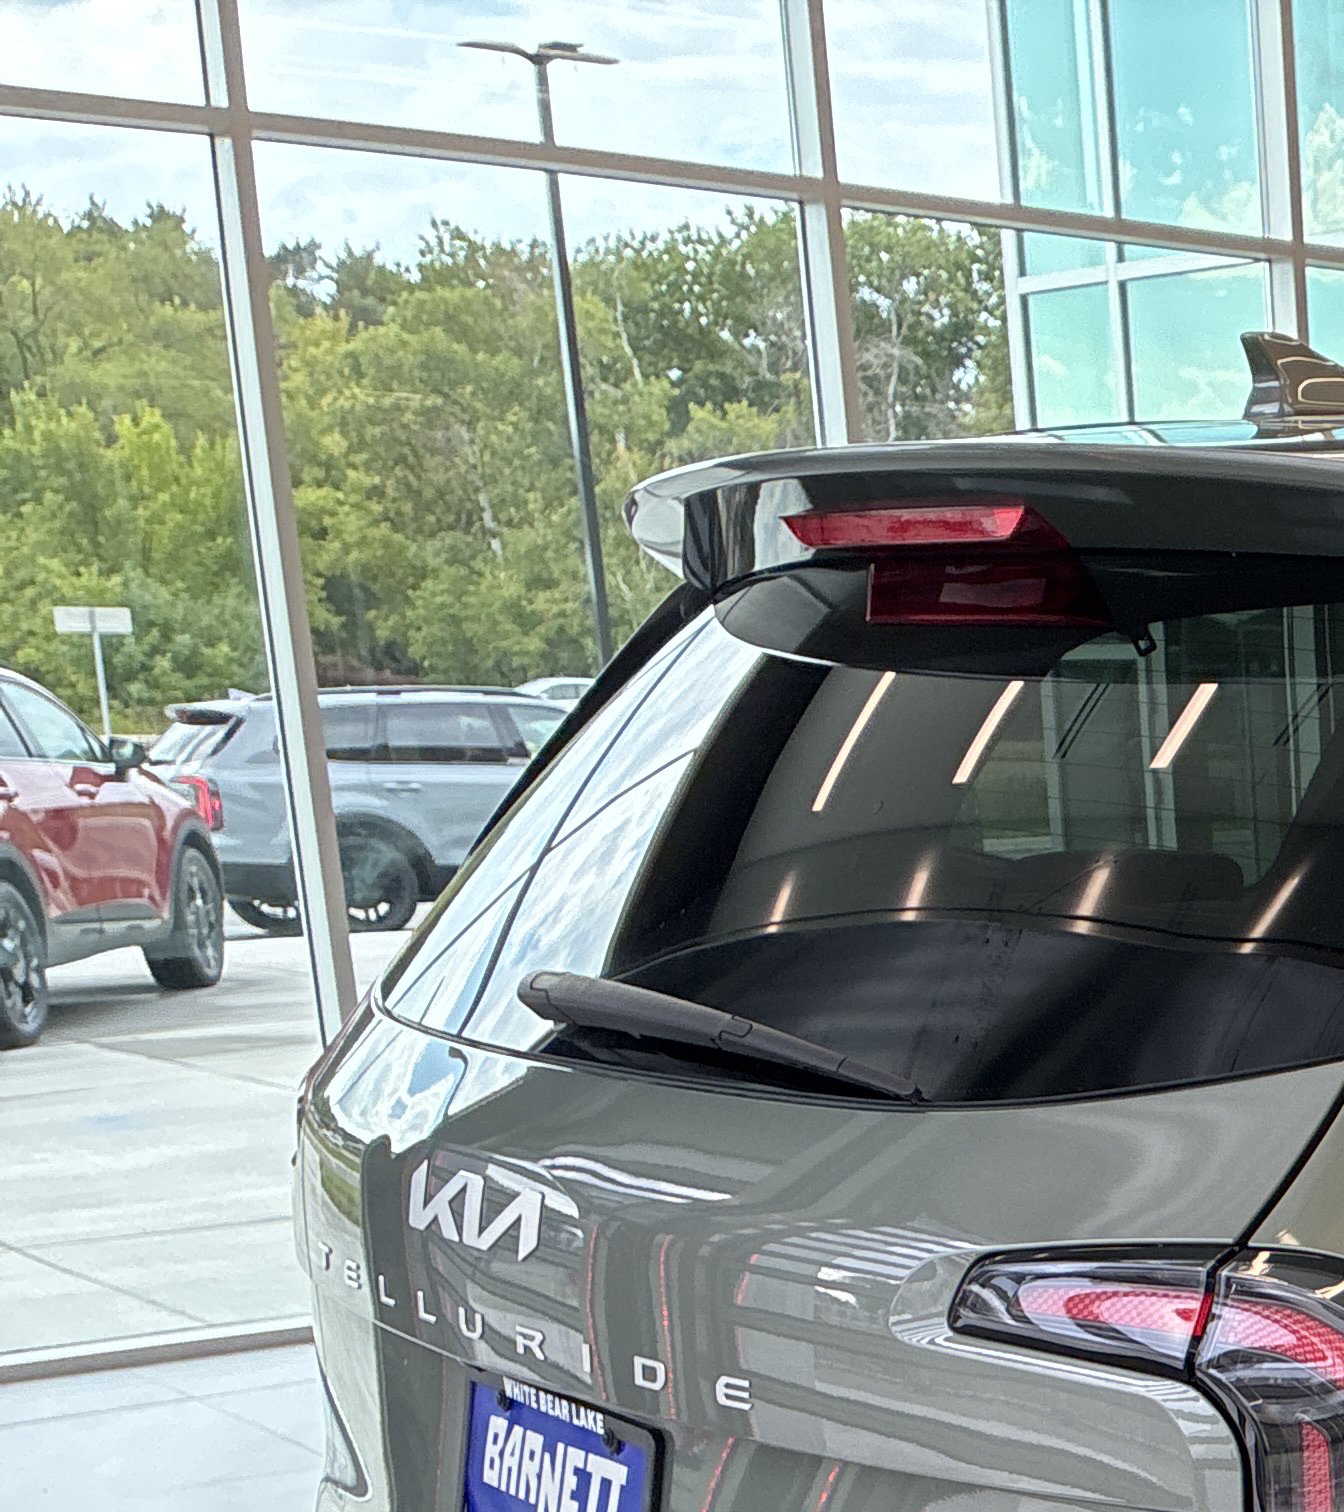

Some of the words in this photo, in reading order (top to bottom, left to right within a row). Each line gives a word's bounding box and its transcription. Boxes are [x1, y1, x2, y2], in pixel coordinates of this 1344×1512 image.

[407, 1159, 546, 1263] KIA
[503, 1376, 538, 1407] WHITE
[539, 1388, 570, 1424] BEAR
[571, 1402, 605, 1435] LAKE
